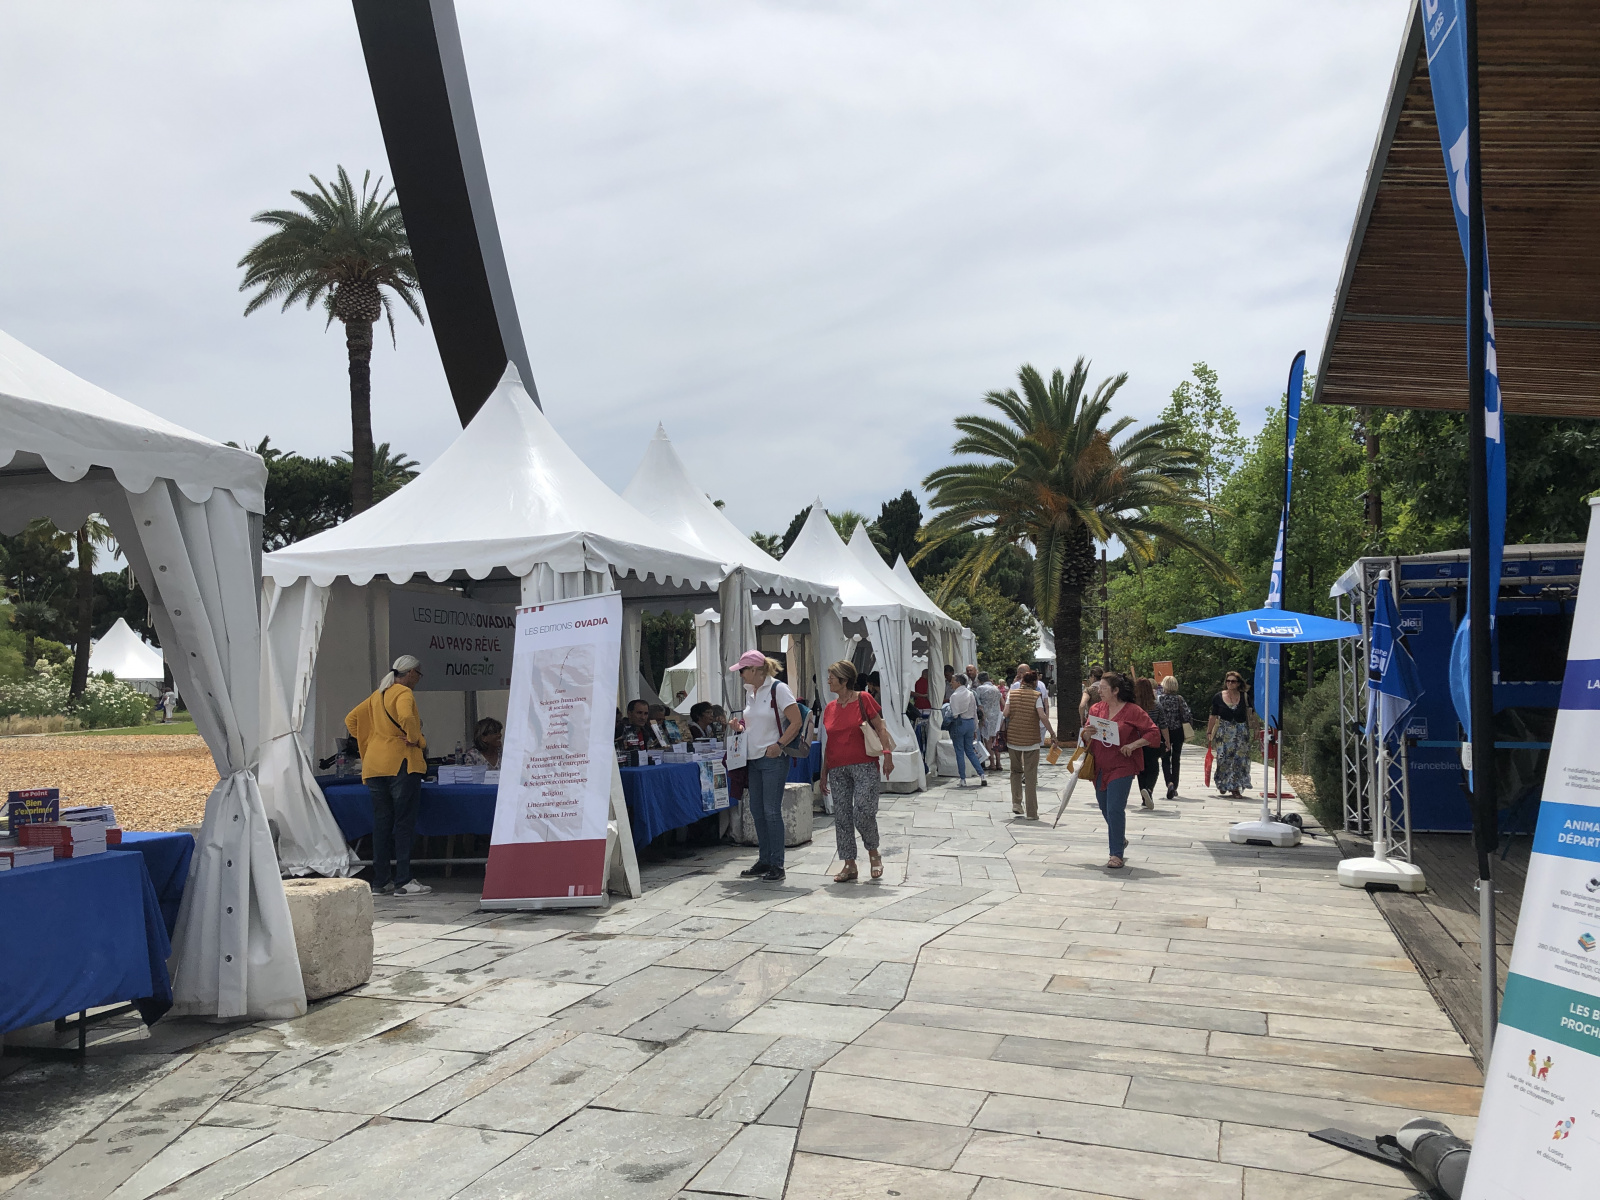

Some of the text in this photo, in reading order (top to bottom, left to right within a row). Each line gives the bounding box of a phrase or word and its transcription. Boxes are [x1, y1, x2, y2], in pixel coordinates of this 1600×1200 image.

[412, 607, 516, 629] LES EDITIONS OVADIA
[1401, 618, 1422, 627] bleu
[525, 617, 608, 636] LES EDITIONS OVADIA
[430, 635, 502, 652] AU PAYS RÊVÉ
[1410, 762, 1461, 770] francebleu
[14, 806, 54, 816] s'exprimer
[1564, 819, 1600, 832] ANIMA
[1558, 832, 1600, 848] DÉPART
[1560, 950, 1588, 962] documents
[1570, 1002, 1590, 1018] LES
[1507, 1072, 1518, 1081] Lieu
[1541, 1086, 1550, 1095] lien
[1550, 1092, 1566, 1102] social
[1526, 1090, 1554, 1106] citoyenneté
[1548, 1146, 1564, 1158] Loisirs
[1542, 1152, 1572, 1171] découvertes
